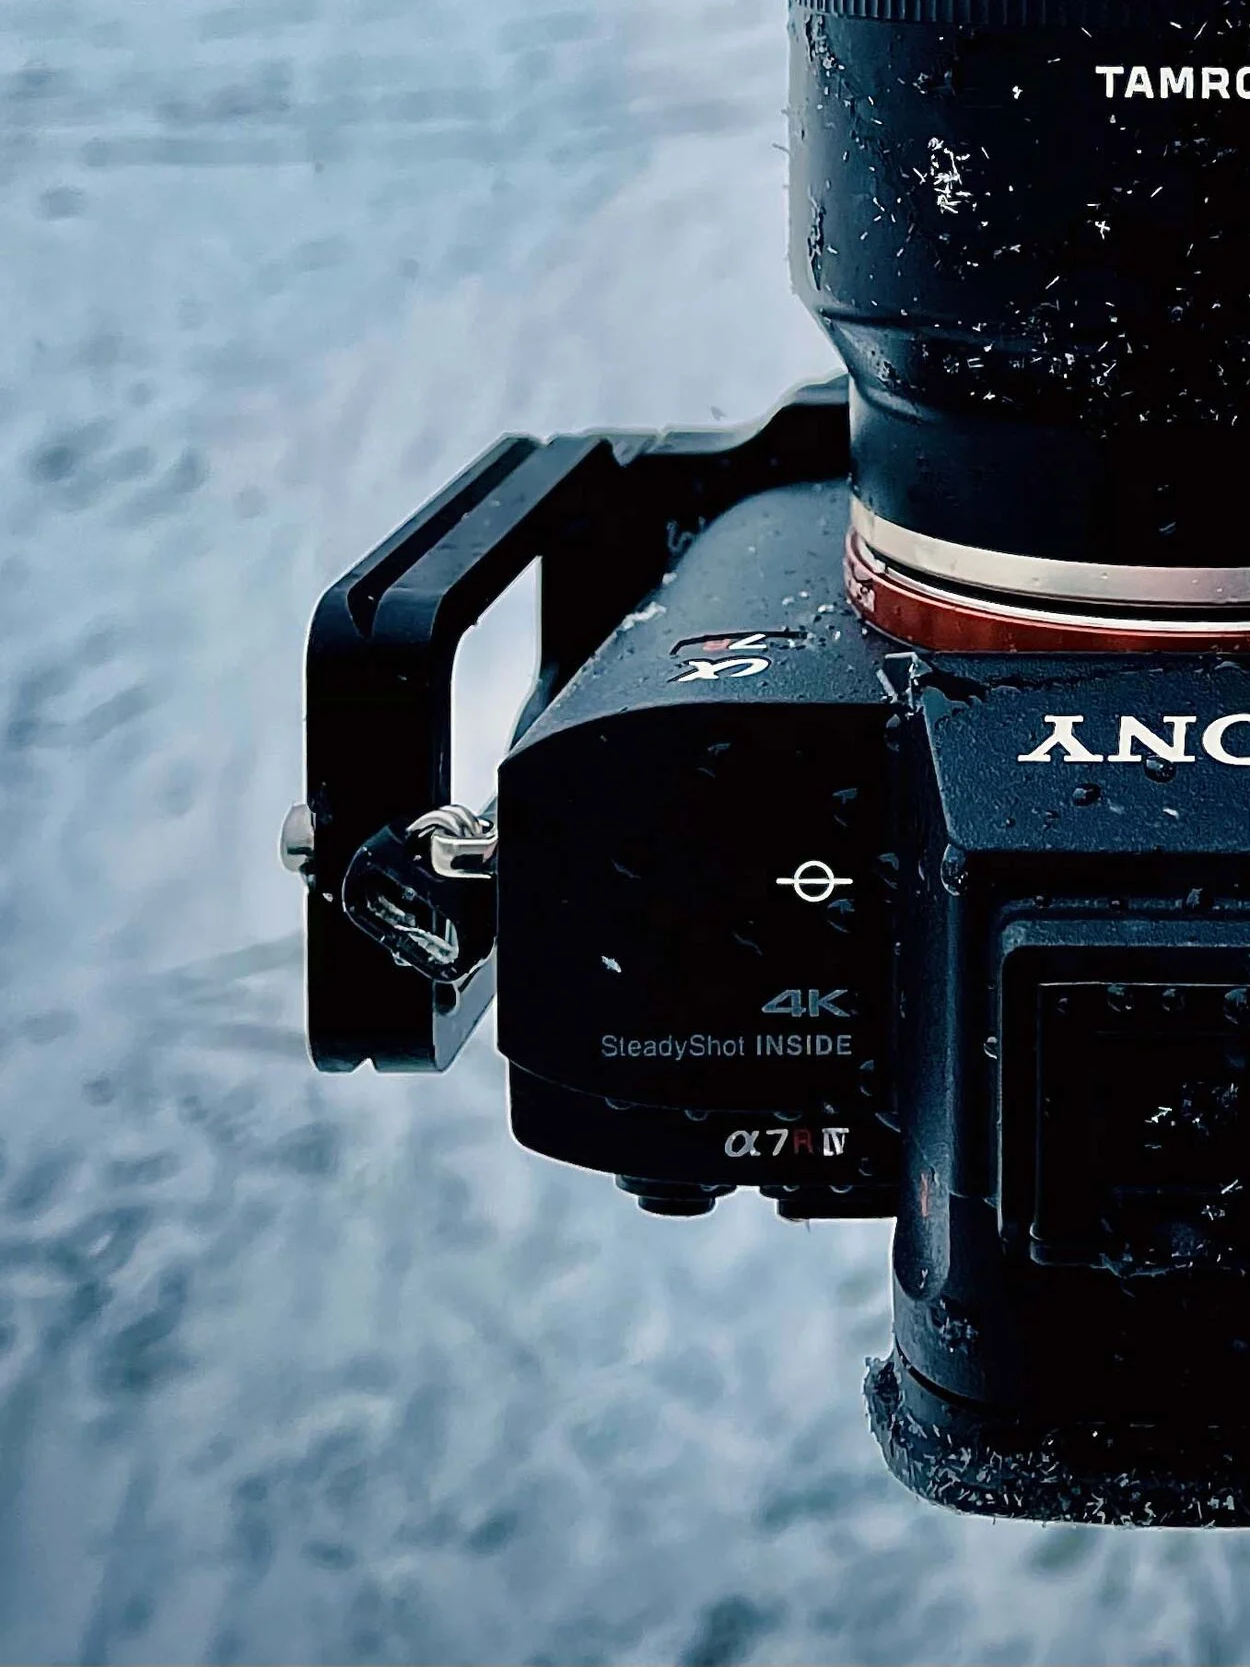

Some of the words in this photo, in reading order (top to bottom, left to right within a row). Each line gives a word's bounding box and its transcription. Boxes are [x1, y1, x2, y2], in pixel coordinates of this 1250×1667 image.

[761, 989, 851, 1017] 4K
[600, 1034, 746, 1060] SteadyShot
[756, 1034, 852, 1056] INSIDE
